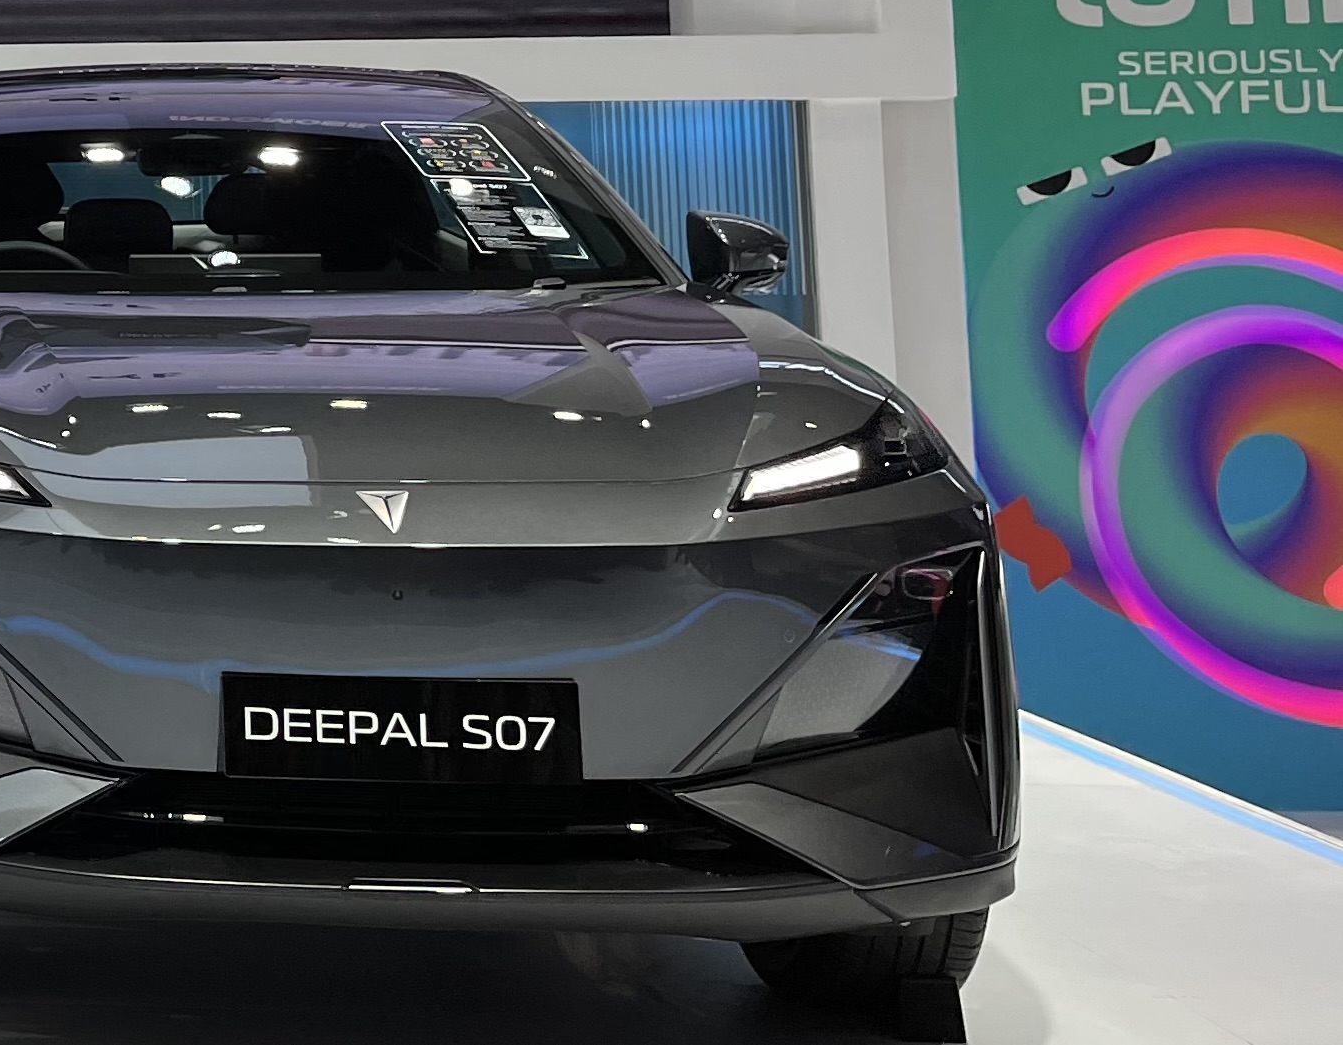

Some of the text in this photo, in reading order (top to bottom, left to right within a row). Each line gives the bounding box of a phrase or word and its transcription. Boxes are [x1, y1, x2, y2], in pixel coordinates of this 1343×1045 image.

[1117, 49, 1343, 77] SERIOUSLY
[1080, 79, 1343, 117] PLAYFUL
[242, 705, 556, 752] DEEPAL S07
